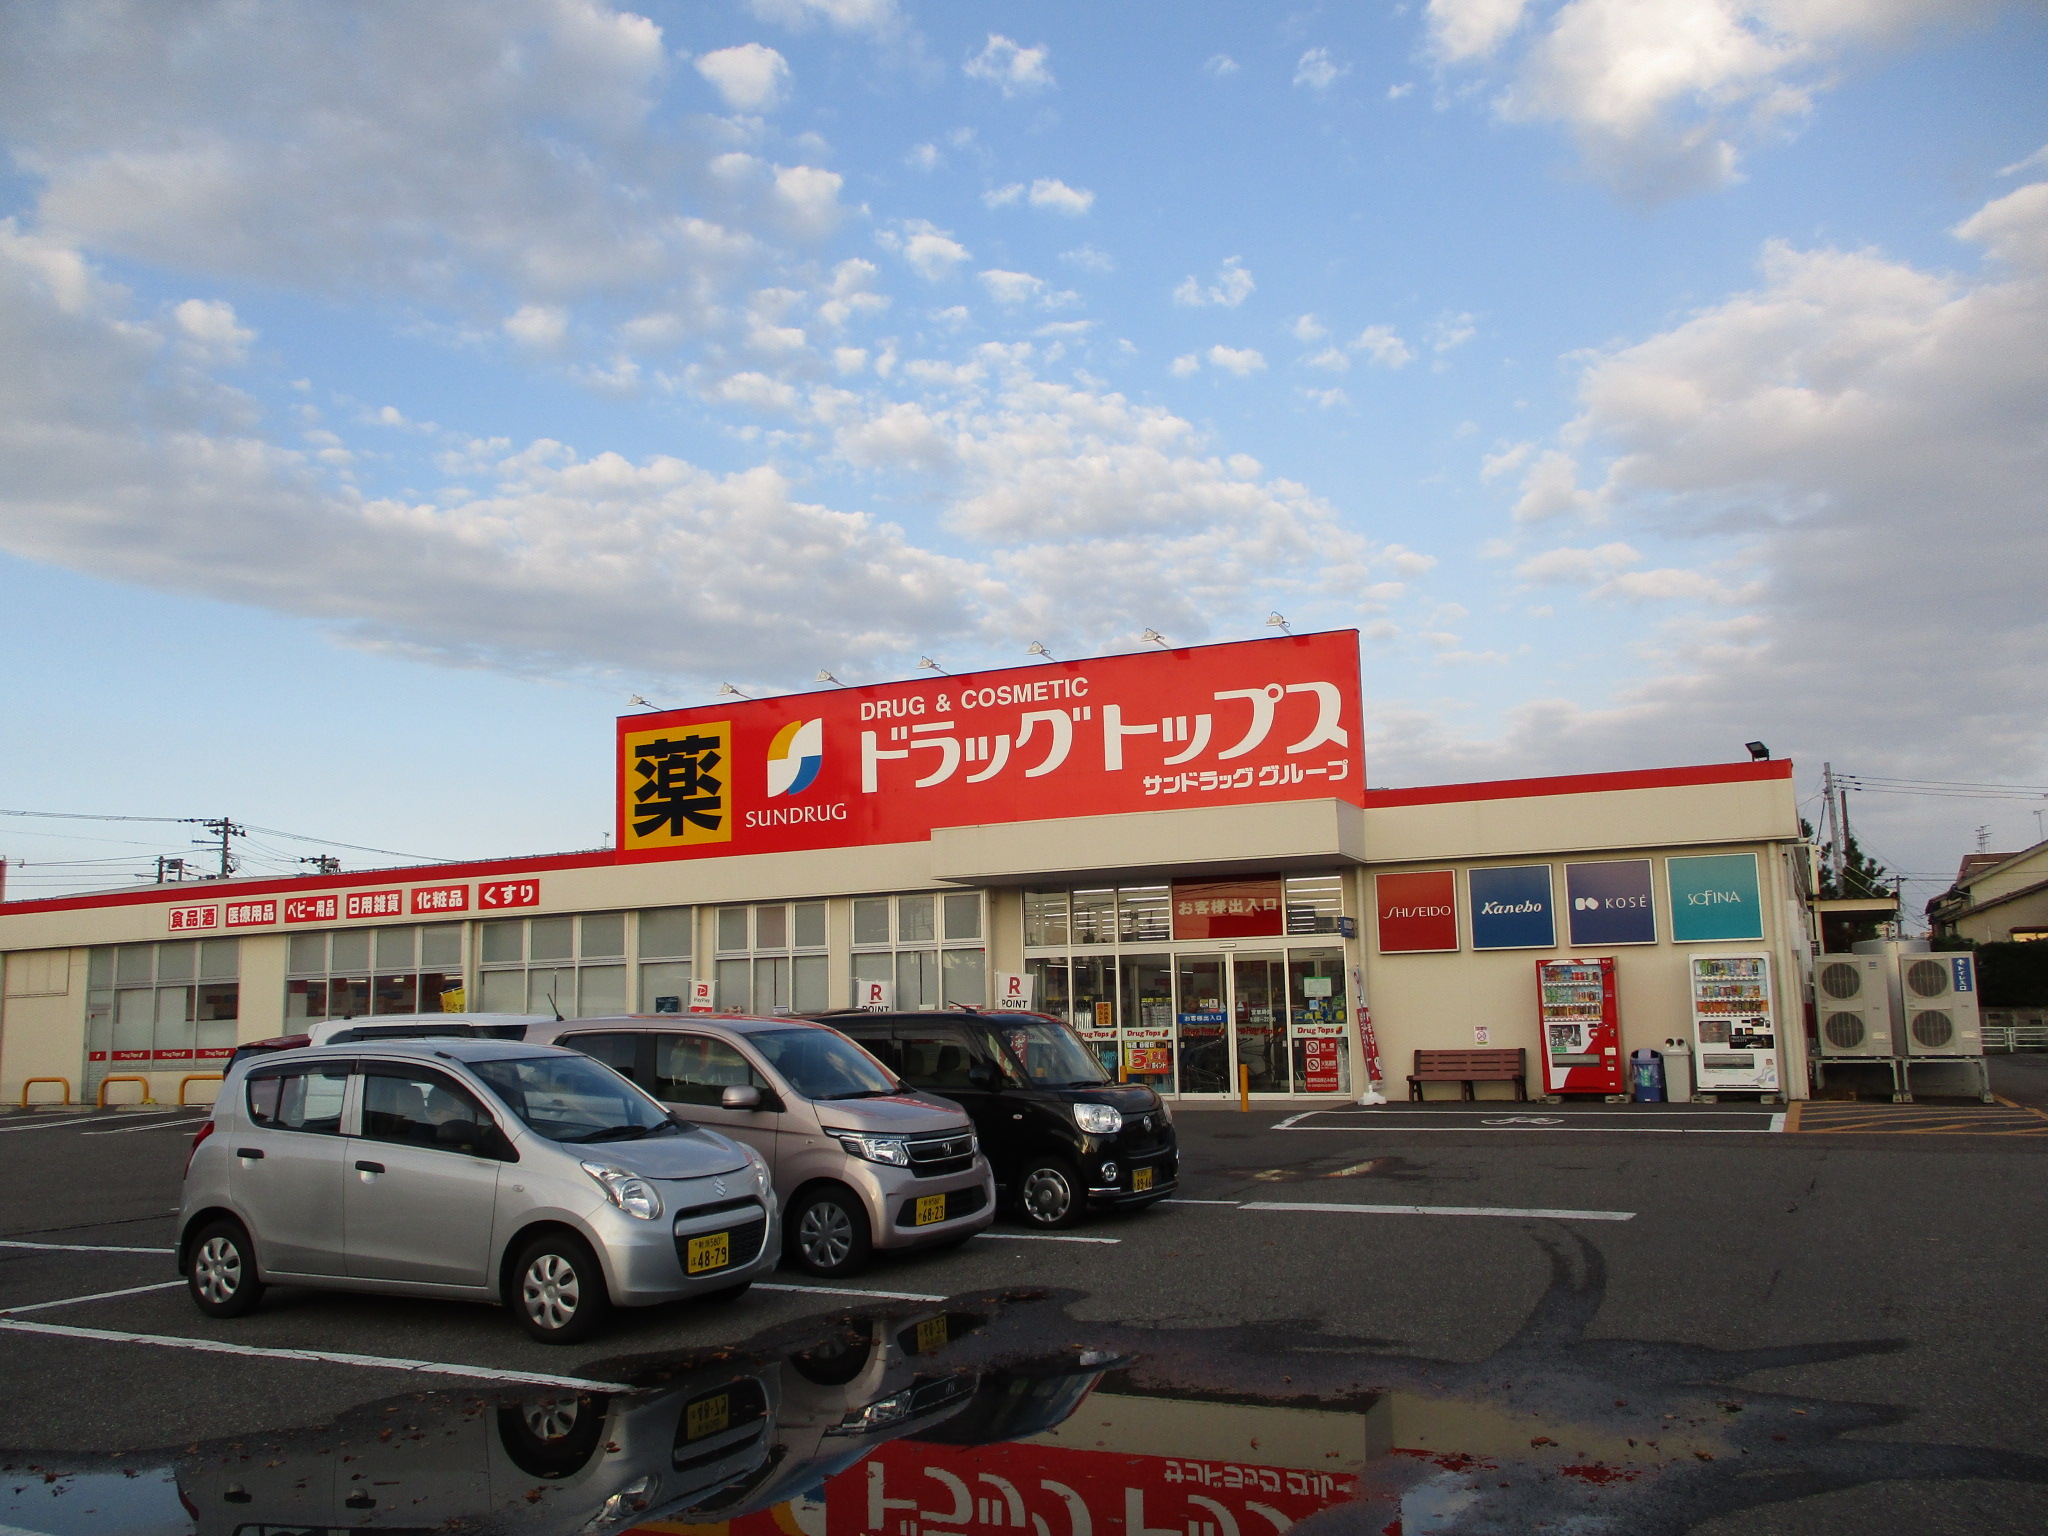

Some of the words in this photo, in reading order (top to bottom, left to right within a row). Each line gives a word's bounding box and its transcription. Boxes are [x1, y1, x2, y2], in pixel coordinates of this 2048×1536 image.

[860, 695, 925, 721] DRUG
[936, 693, 952, 713] &
[961, 677, 1089, 709] COSMETIC
[861, 681, 1349, 794] ドラッグトップス
[631, 735, 723, 837] 薬
[745, 803, 847, 828] SUNDRUG
[416, 889, 463, 910] 化粧品
[484, 884, 533, 905] くすり
[1605, 894, 1647, 909] KOSÉ
[1687, 889, 1741, 906] SOFINA
[287, 899, 335, 918] ベビー用品
[349, 893, 399, 915] 日用雑貨
[1178, 898, 1277, 916] お客様出入口
[1383, 905, 1451, 919] SHISEIDO
[1481, 900, 1542, 915] Kanebo
[228, 904, 274, 924] 医療用品
[870, 984, 882, 1000] R
[1009, 976, 1021, 994] R
[1002, 999, 1028, 1009] POINT
[1127, 1030, 1145, 1038] Drug
[1297, 1026, 1316, 1035] Drug
[1317, 1026, 1334, 1034] Tops
[923, 1206, 943, 1222] 68-23
[698, 1247, 727, 1268] 48-79
